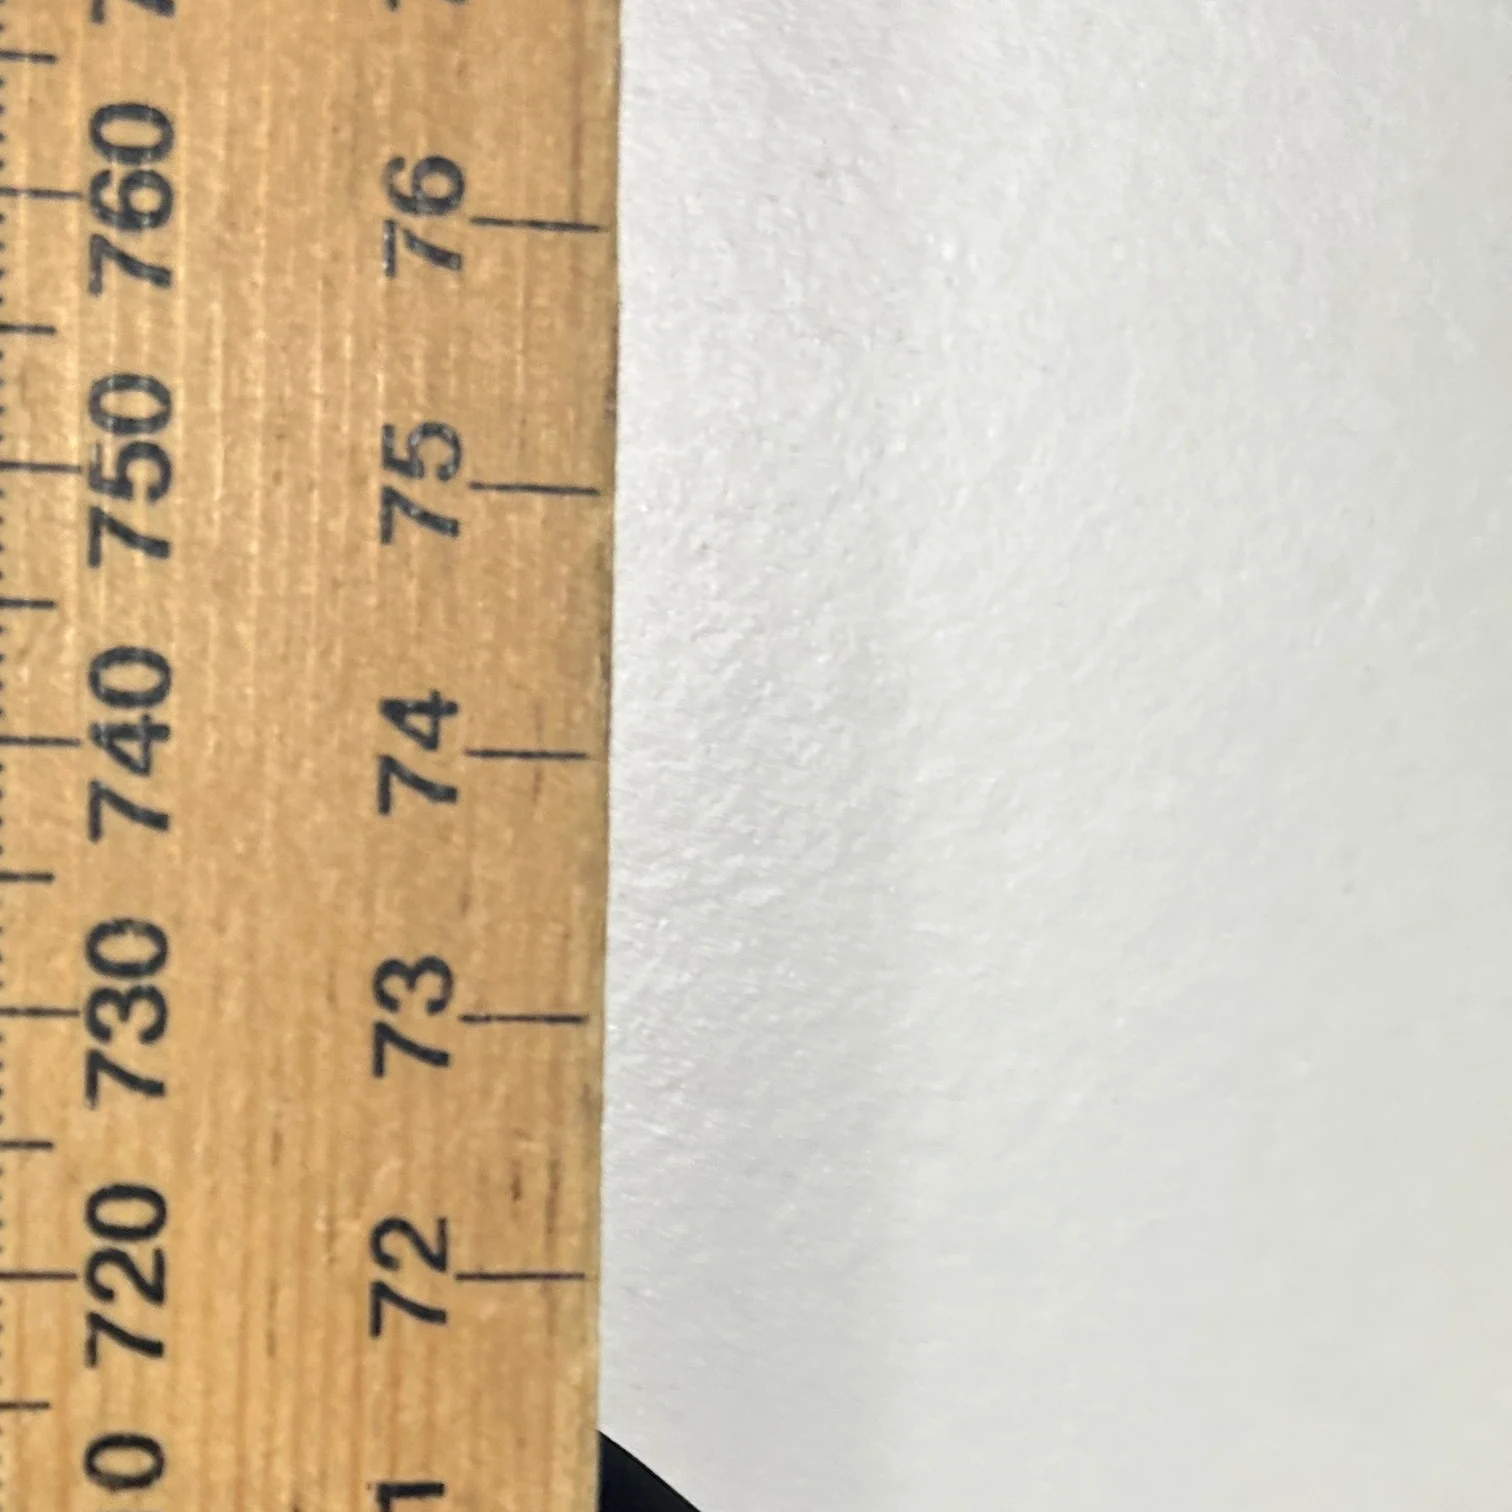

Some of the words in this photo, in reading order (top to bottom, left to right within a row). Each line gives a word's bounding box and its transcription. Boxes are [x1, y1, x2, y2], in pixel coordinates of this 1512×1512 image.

[89, 102, 174, 294] 760
[384, 155, 465, 277] 76
[88, 373, 172, 567] 750
[381, 422, 462, 544] 75
[88, 646, 172, 842] 740
[378, 690, 459, 816] 74
[85, 918, 169, 1106] 730
[372, 955, 454, 1078] 73
[84, 1183, 167, 1367] 720
[369, 1216, 449, 1338] 72
